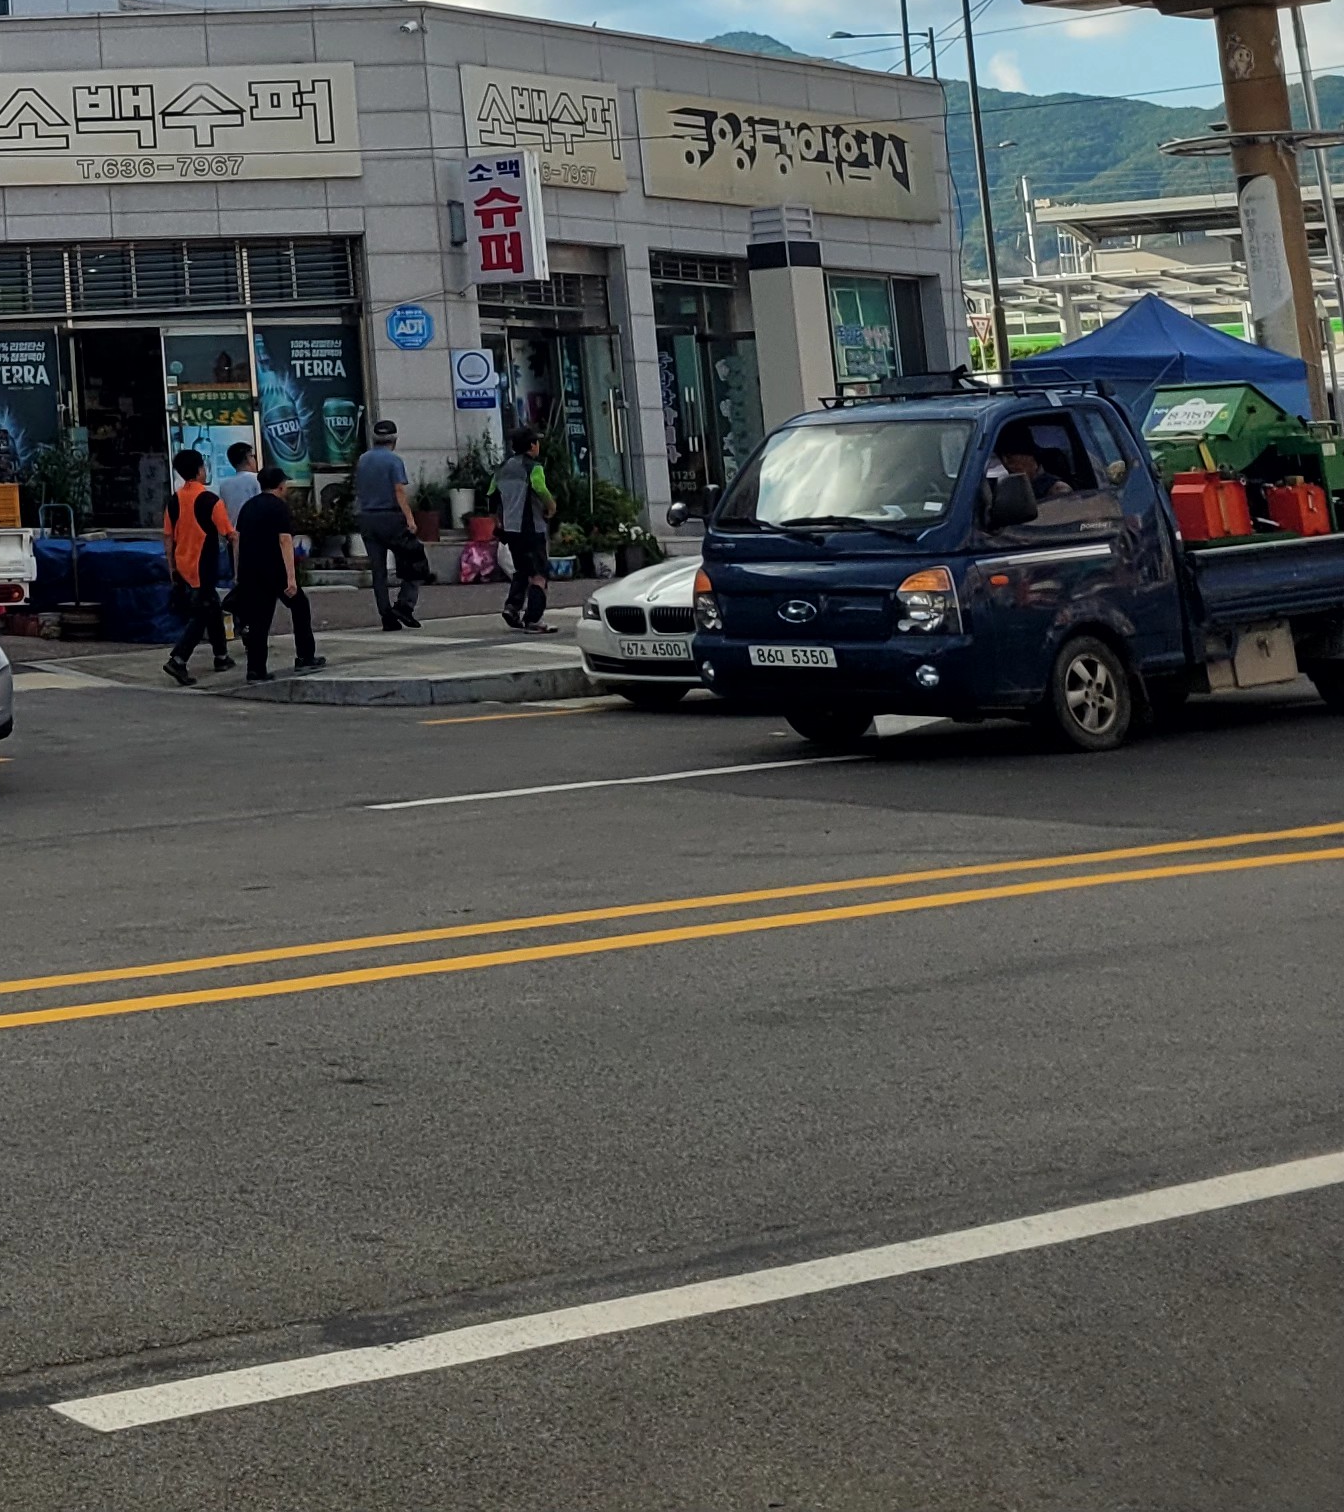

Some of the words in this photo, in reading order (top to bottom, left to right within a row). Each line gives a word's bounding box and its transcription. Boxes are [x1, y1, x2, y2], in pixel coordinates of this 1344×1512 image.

[476, 82, 622, 160] 소백수퍼
[76, 155, 245, 180] T.636-7967
[395, 319, 425, 335] ADT
[290, 360, 347, 379] TERRA
[325, 416, 354, 427] TERRA
[652, 641, 682, 657] 4500
[791, 649, 829, 665] 5350
